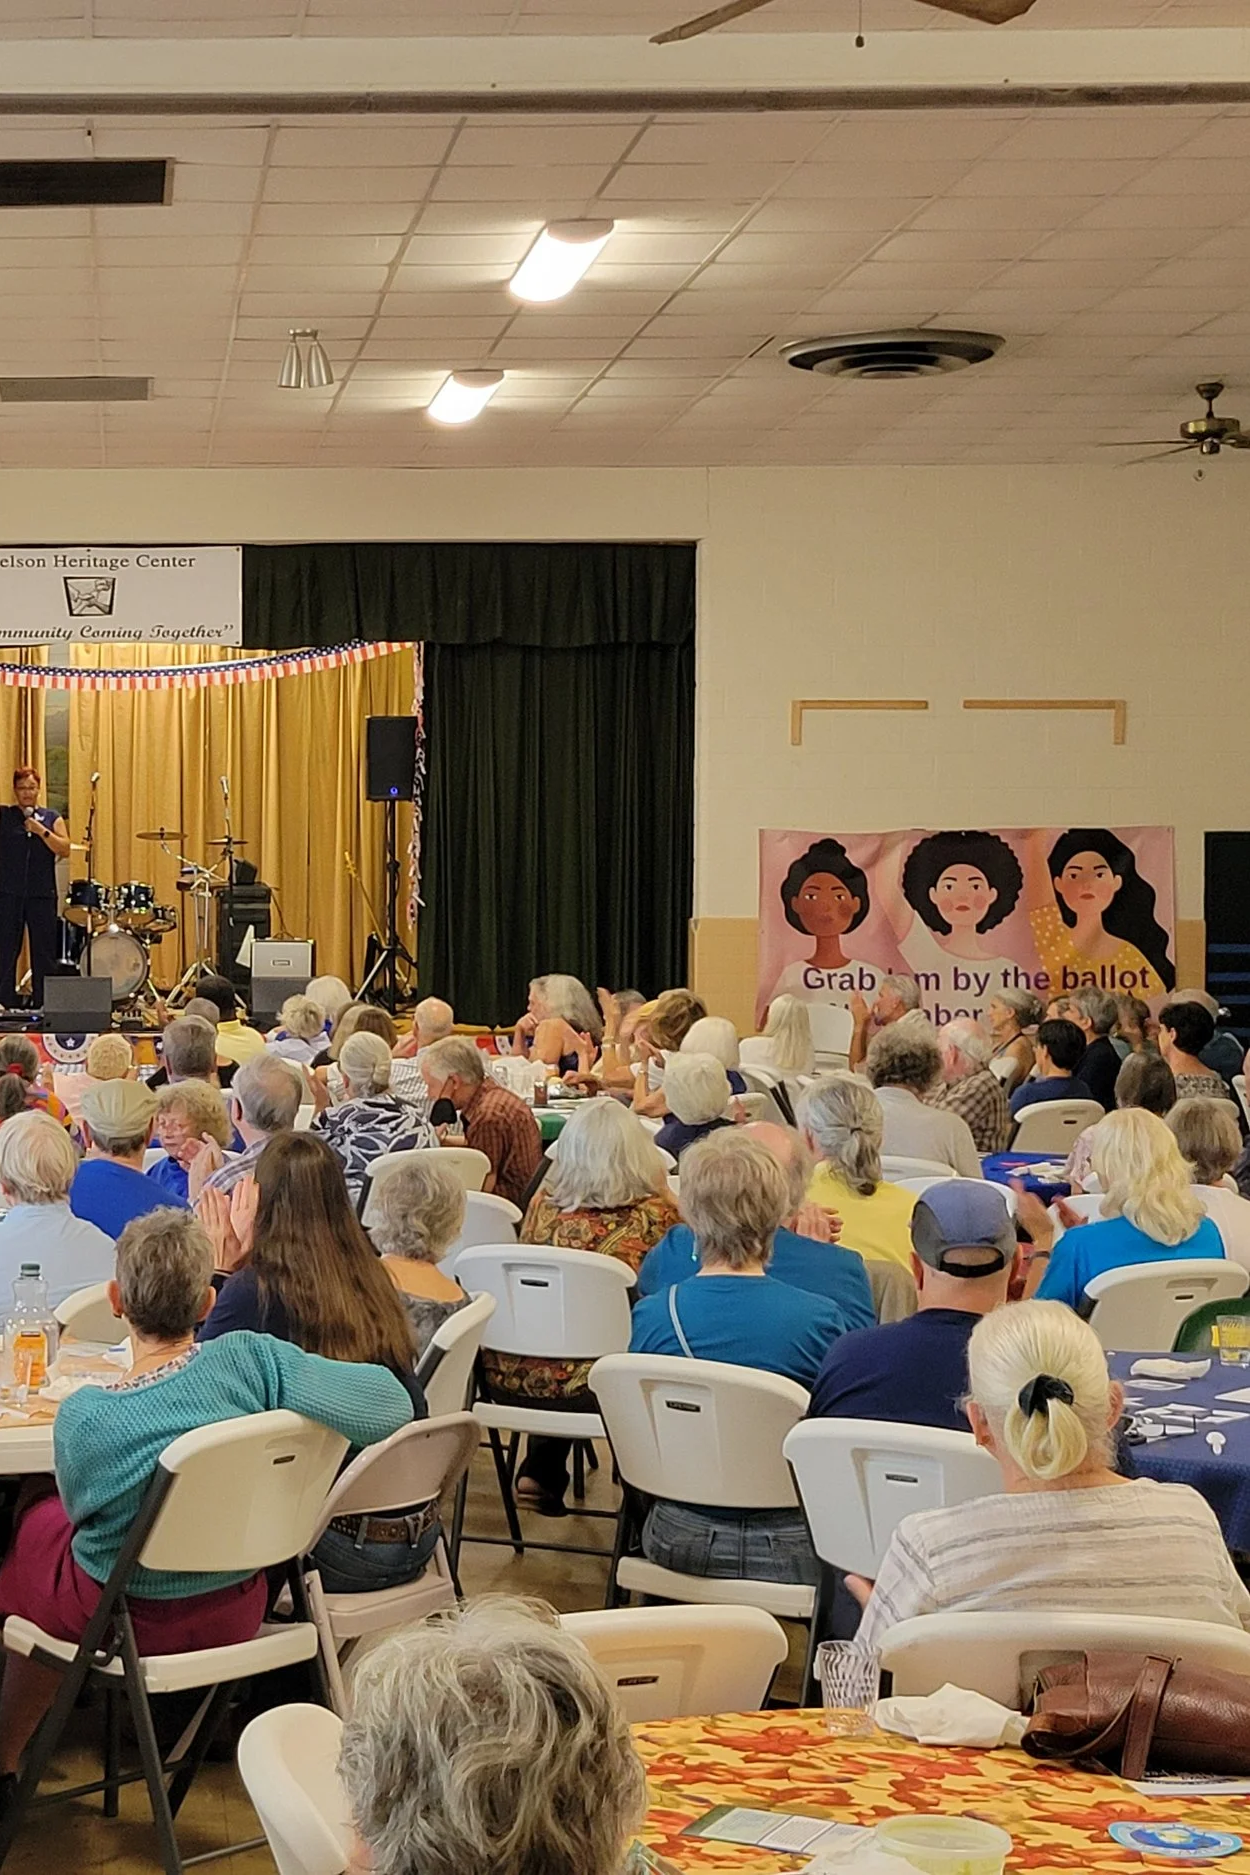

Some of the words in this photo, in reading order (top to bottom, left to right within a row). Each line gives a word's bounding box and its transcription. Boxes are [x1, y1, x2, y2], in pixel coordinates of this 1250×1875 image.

[53, 554, 130, 571] Heritage
[136, 554, 196, 568] Center
[80, 624, 143, 640] Coming
[803, 967, 876, 991] Grab
[887, 968, 941, 991] 'm
[953, 966, 991, 997] by
[1001, 966, 1050, 990] the
[1062, 965, 1150, 989] ballot
